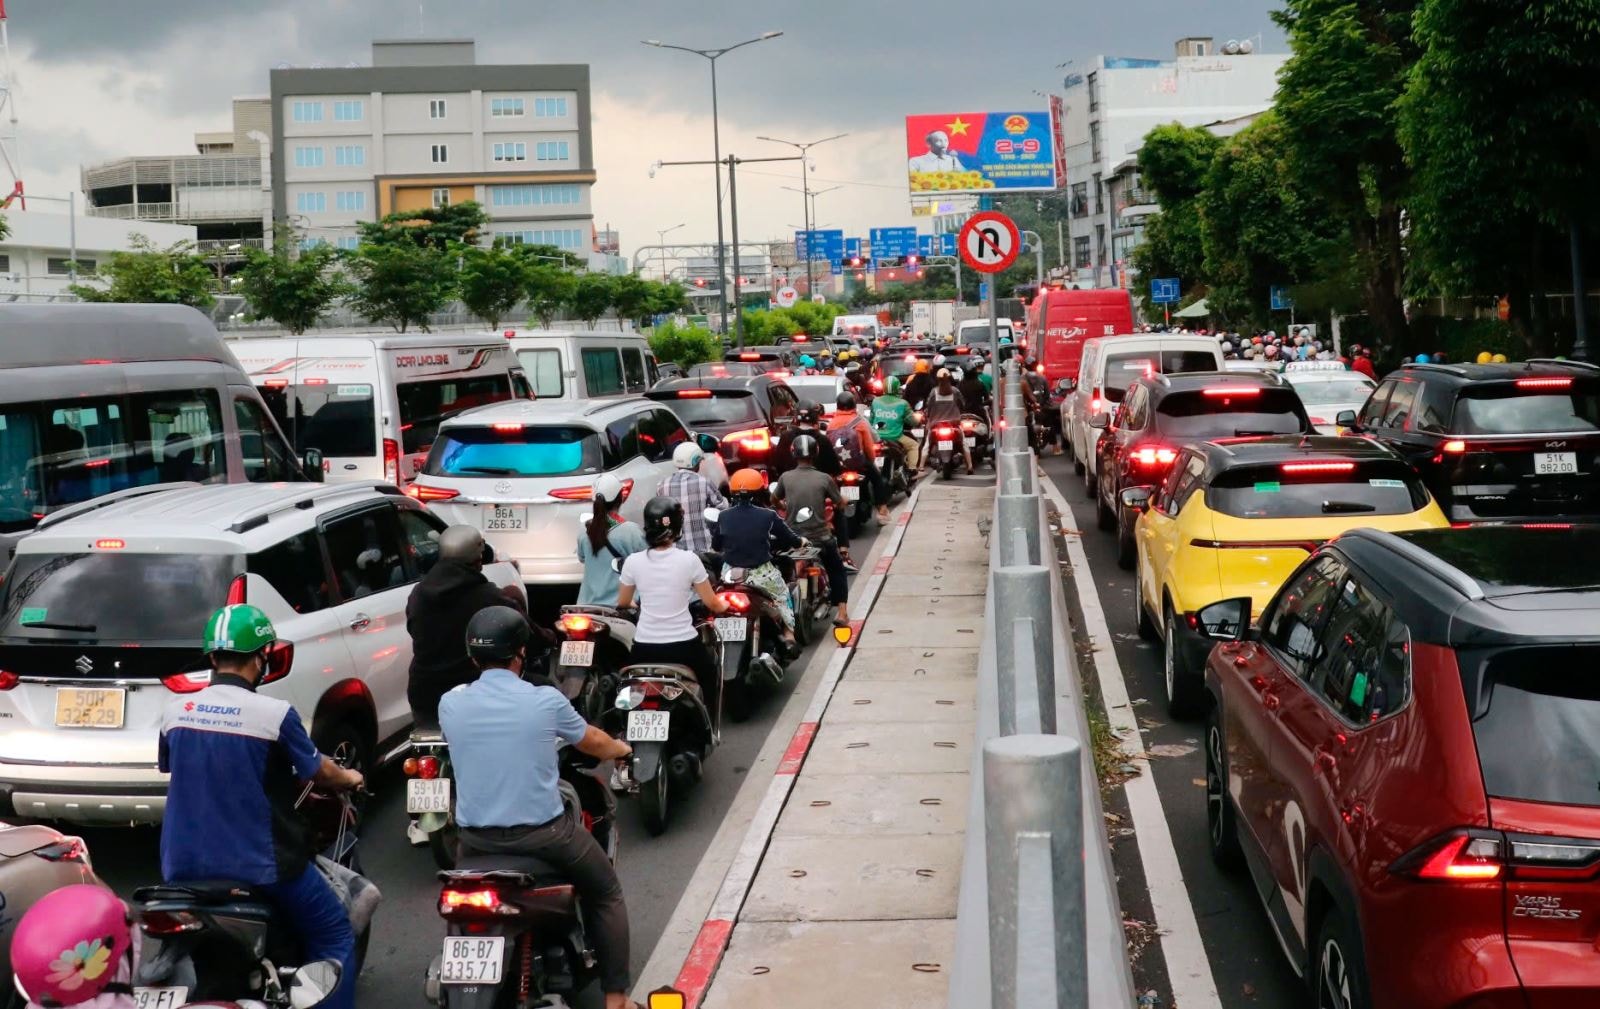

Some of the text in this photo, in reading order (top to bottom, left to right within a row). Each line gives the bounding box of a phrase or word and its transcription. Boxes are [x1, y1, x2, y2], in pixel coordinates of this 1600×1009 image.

[995, 139, 1041, 154] 2-9
[875, 409, 898, 419] Grab
[495, 508, 514, 519] 86A
[488, 519, 522, 529] 266.32
[197, 704, 242, 716] SUZUKI
[630, 726, 666, 739] 807.13
[414, 781, 443, 795] 59-VA
[409, 796, 449, 810] 020.64
[1515, 894, 1562, 908] YARIS
[1512, 906, 1582, 919] CROSS
[452, 940, 495, 959] 86-B7
[444, 961, 497, 980] 335.71
